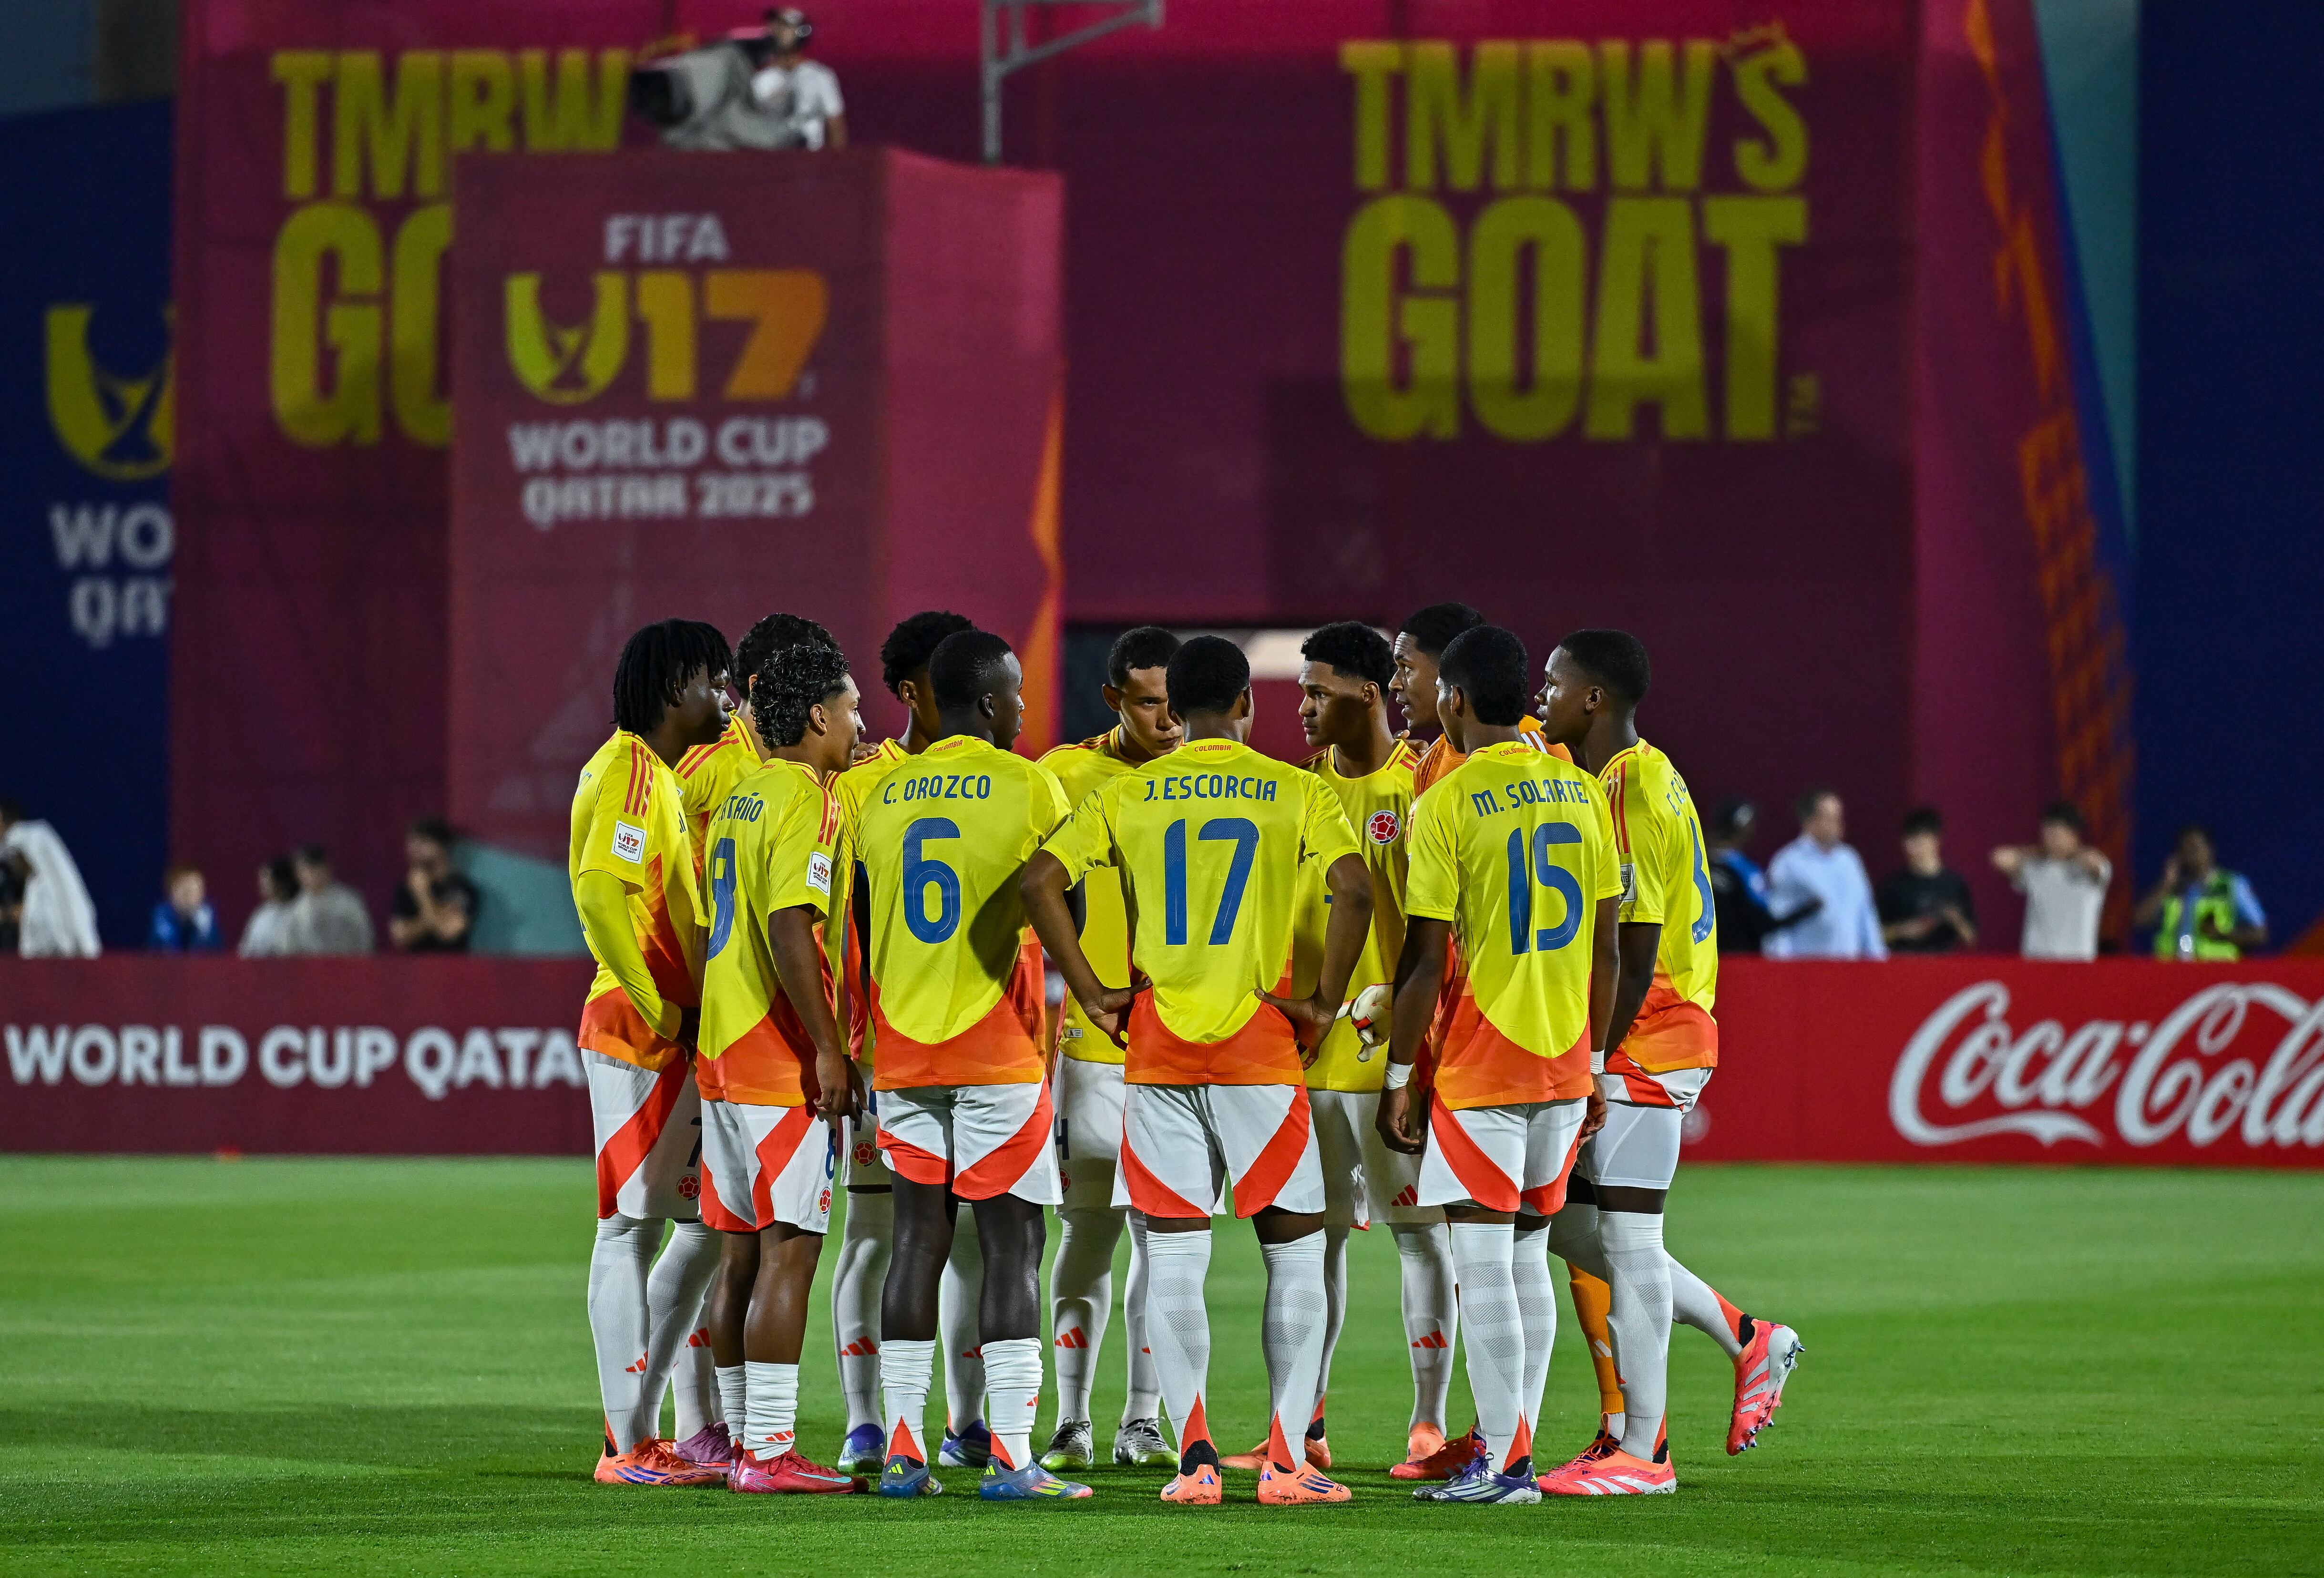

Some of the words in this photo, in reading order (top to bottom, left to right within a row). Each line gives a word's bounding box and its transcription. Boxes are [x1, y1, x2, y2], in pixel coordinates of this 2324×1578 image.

[604, 213, 731, 262] FIFA
[504, 270, 830, 405] U17
[1341, 195, 1810, 443] GOAT
[508, 420, 706, 471] WORLD
[715, 418, 830, 467] CUP
[521, 477, 689, 530] QATAR
[698, 473, 815, 520] 2025
[69, 577, 176, 648] QA
[932, 739, 963, 751] COLOMBIA
[718, 792, 764, 823] TAÑO
[883, 782, 897, 804] C.
[903, 775, 991, 801] OROZCO
[1144, 779, 1158, 801] J.
[1163, 774, 1278, 802] ESCORCIA
[1471, 789, 1505, 817] M.
[1505, 779, 1589, 809] SOLARTE
[903, 817, 961, 944] 6
[1164, 818, 1260, 945] 17
[1507, 822, 1582, 955] 15
[2, 1023, 248, 1088] WORLD
[259, 1024, 398, 1088] CUP
